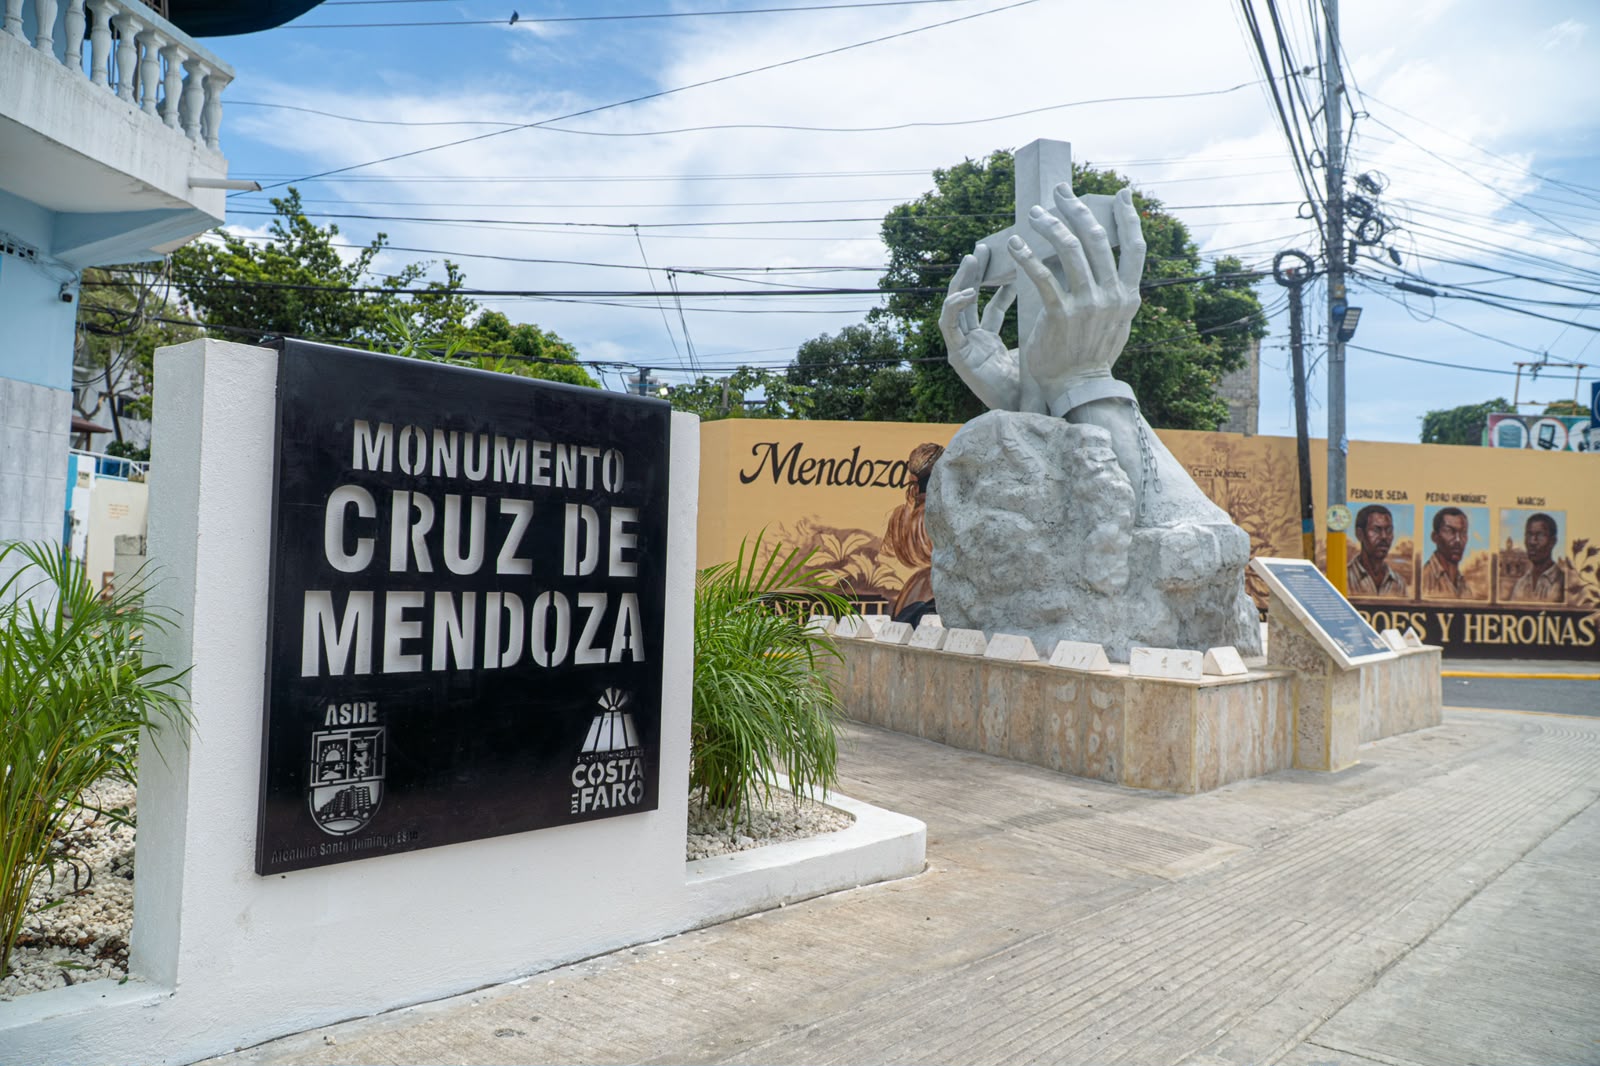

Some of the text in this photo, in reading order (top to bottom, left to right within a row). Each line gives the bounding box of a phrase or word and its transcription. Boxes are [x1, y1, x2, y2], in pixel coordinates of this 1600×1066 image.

[352, 419, 625, 494] MONUMENTO
[739, 442, 911, 489] Mendoza
[1350, 488, 1408, 501] PEDRO DE SEDA
[1426, 492, 1450, 503] PEDRO
[324, 484, 640, 577] CRUZ DE
[301, 590, 645, 677] MENDOZA
[1437, 612, 1454, 643] Y
[1464, 611, 1596, 646] HEROÍNAS
[325, 702, 378, 726] ASDE
[572, 758, 645, 788] COSTA
[571, 790, 579, 814] DEL
[580, 780, 645, 813] FARO
